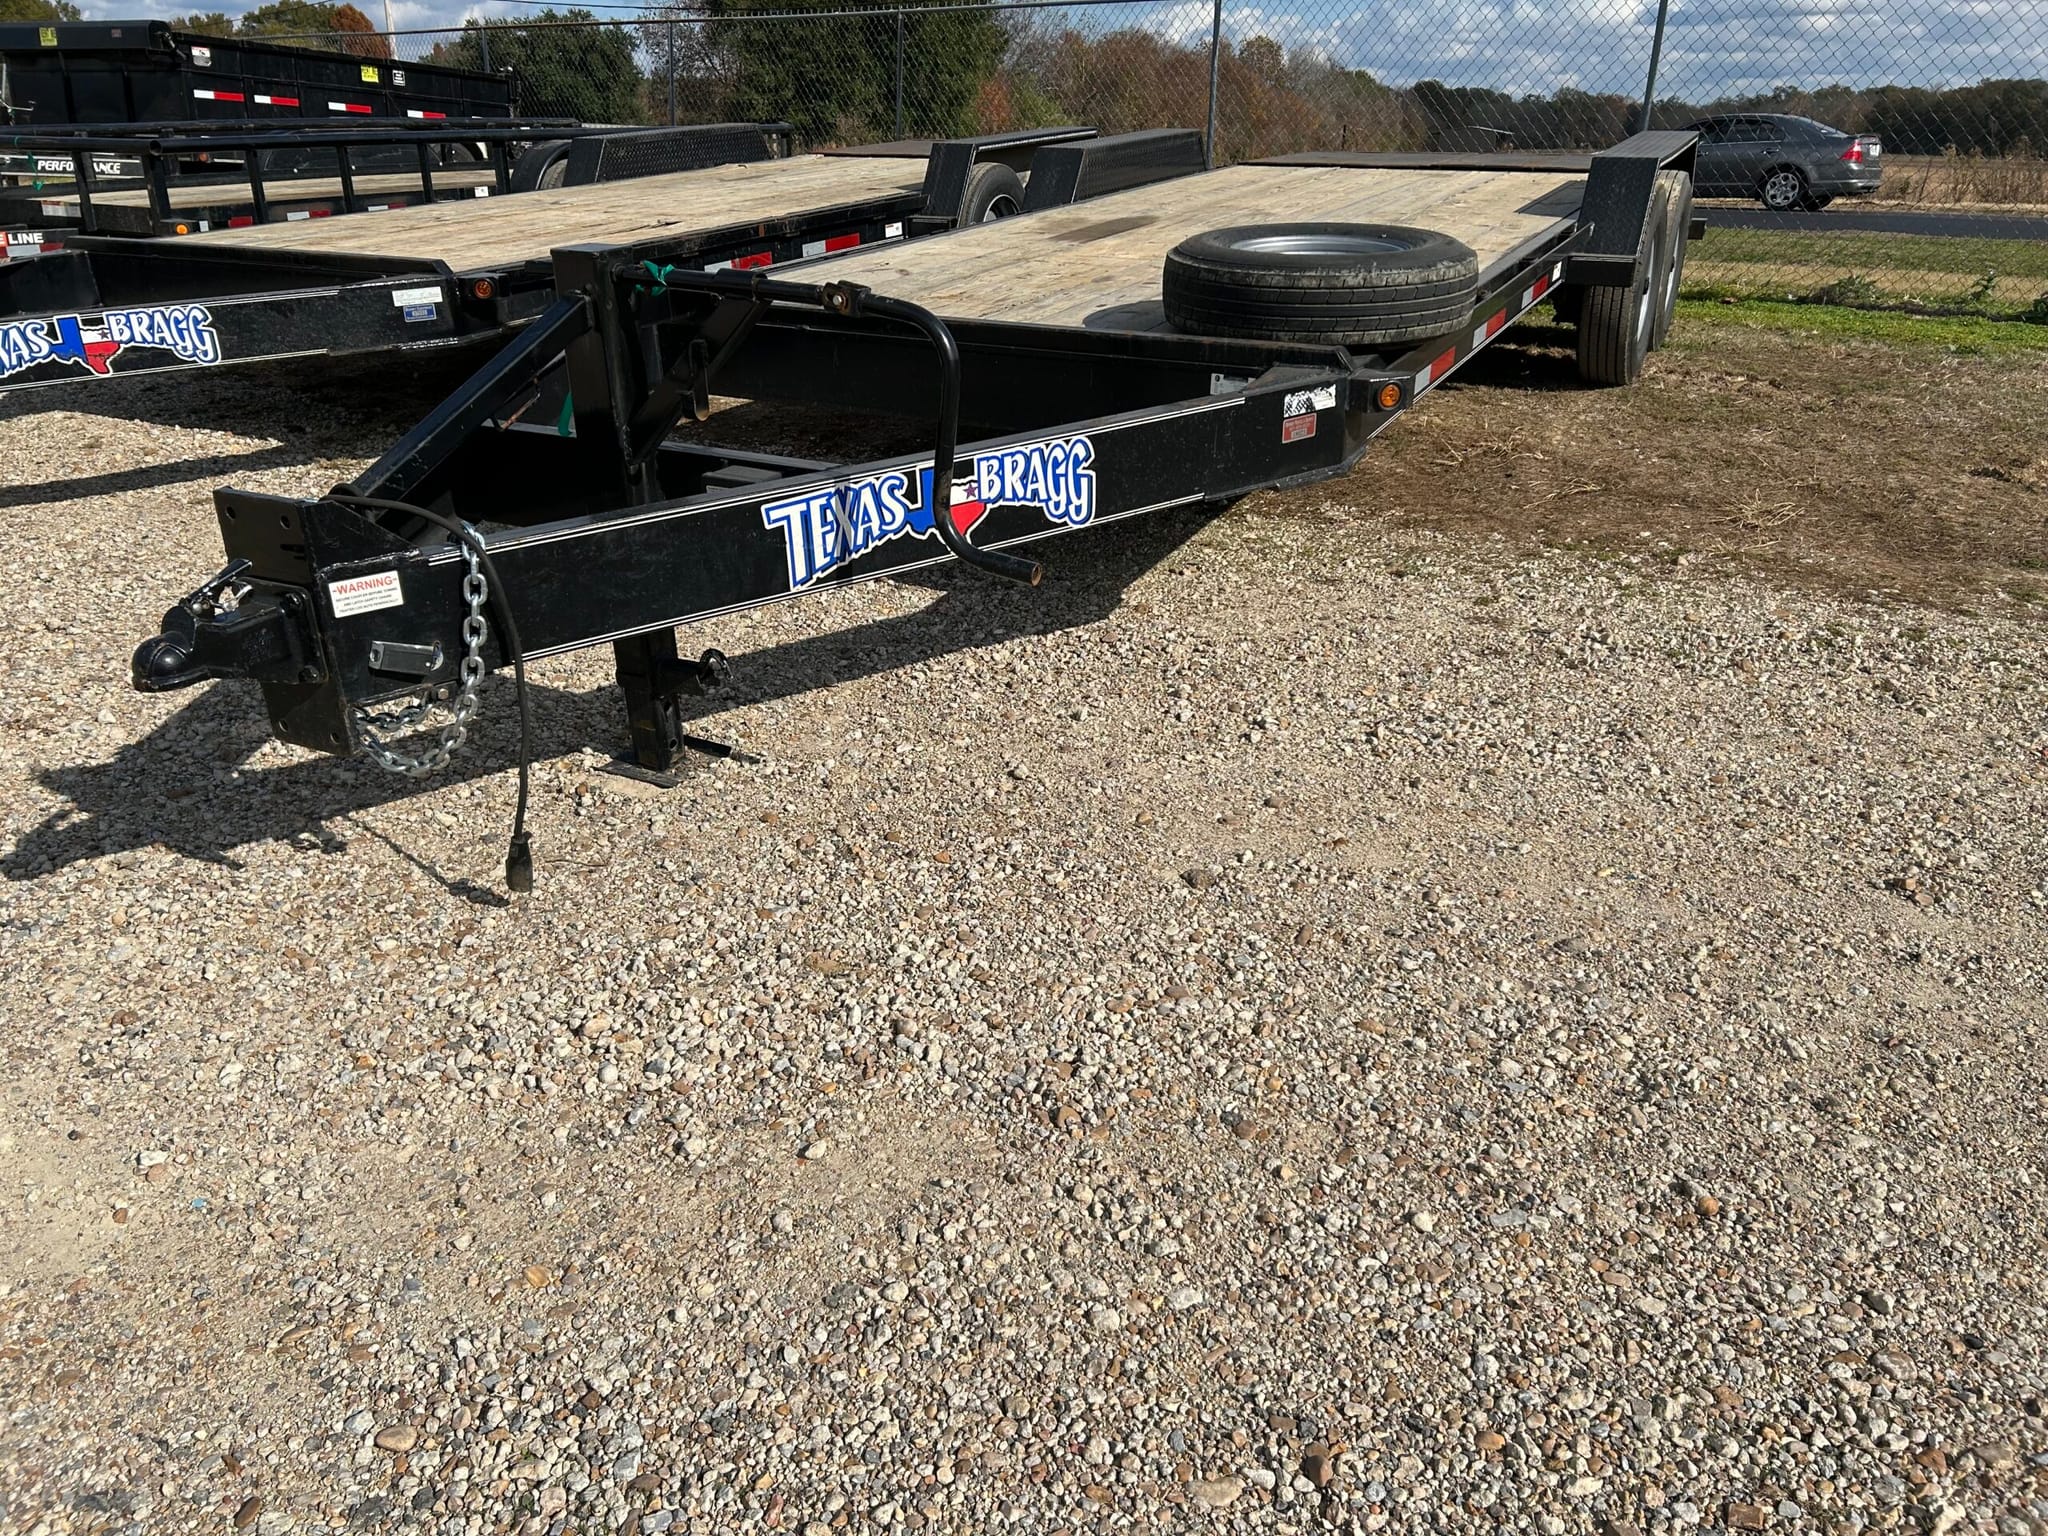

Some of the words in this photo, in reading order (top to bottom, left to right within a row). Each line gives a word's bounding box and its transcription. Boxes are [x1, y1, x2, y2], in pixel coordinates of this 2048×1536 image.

[8, 233, 43, 243] LINE
[105, 306, 219, 365] BRAGG
[762, 475, 907, 592] TEXAS
[975, 436, 1095, 526] BRAGG
